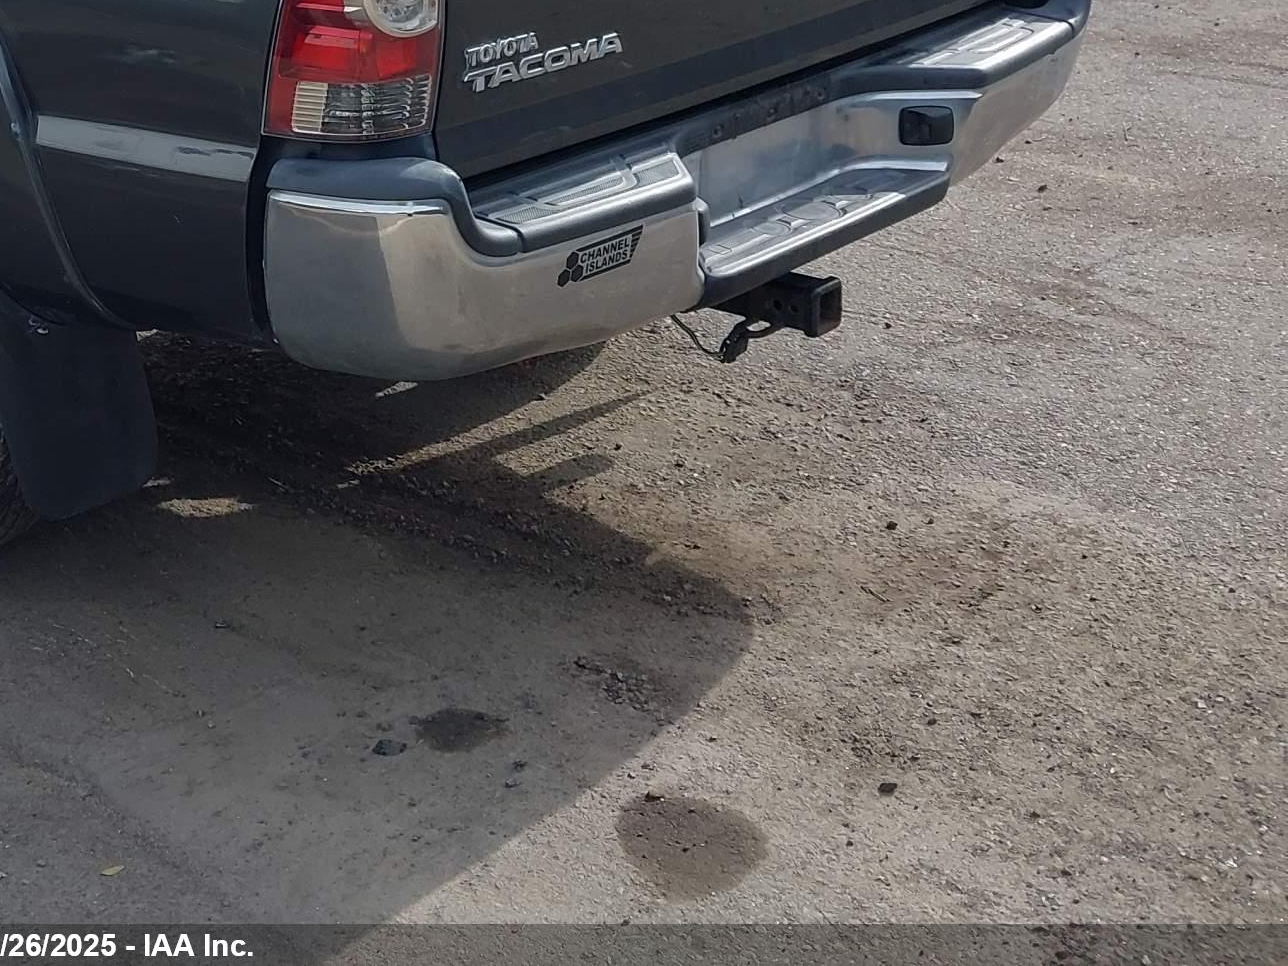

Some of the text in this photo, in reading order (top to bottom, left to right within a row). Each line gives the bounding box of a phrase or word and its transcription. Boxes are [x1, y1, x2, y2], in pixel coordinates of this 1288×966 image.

[462, 32, 624, 93] TACOMA
[464, 31, 540, 69] TOYOTA
[580, 238, 631, 264] CHANNEL
[585, 248, 629, 274] ISLANDS
